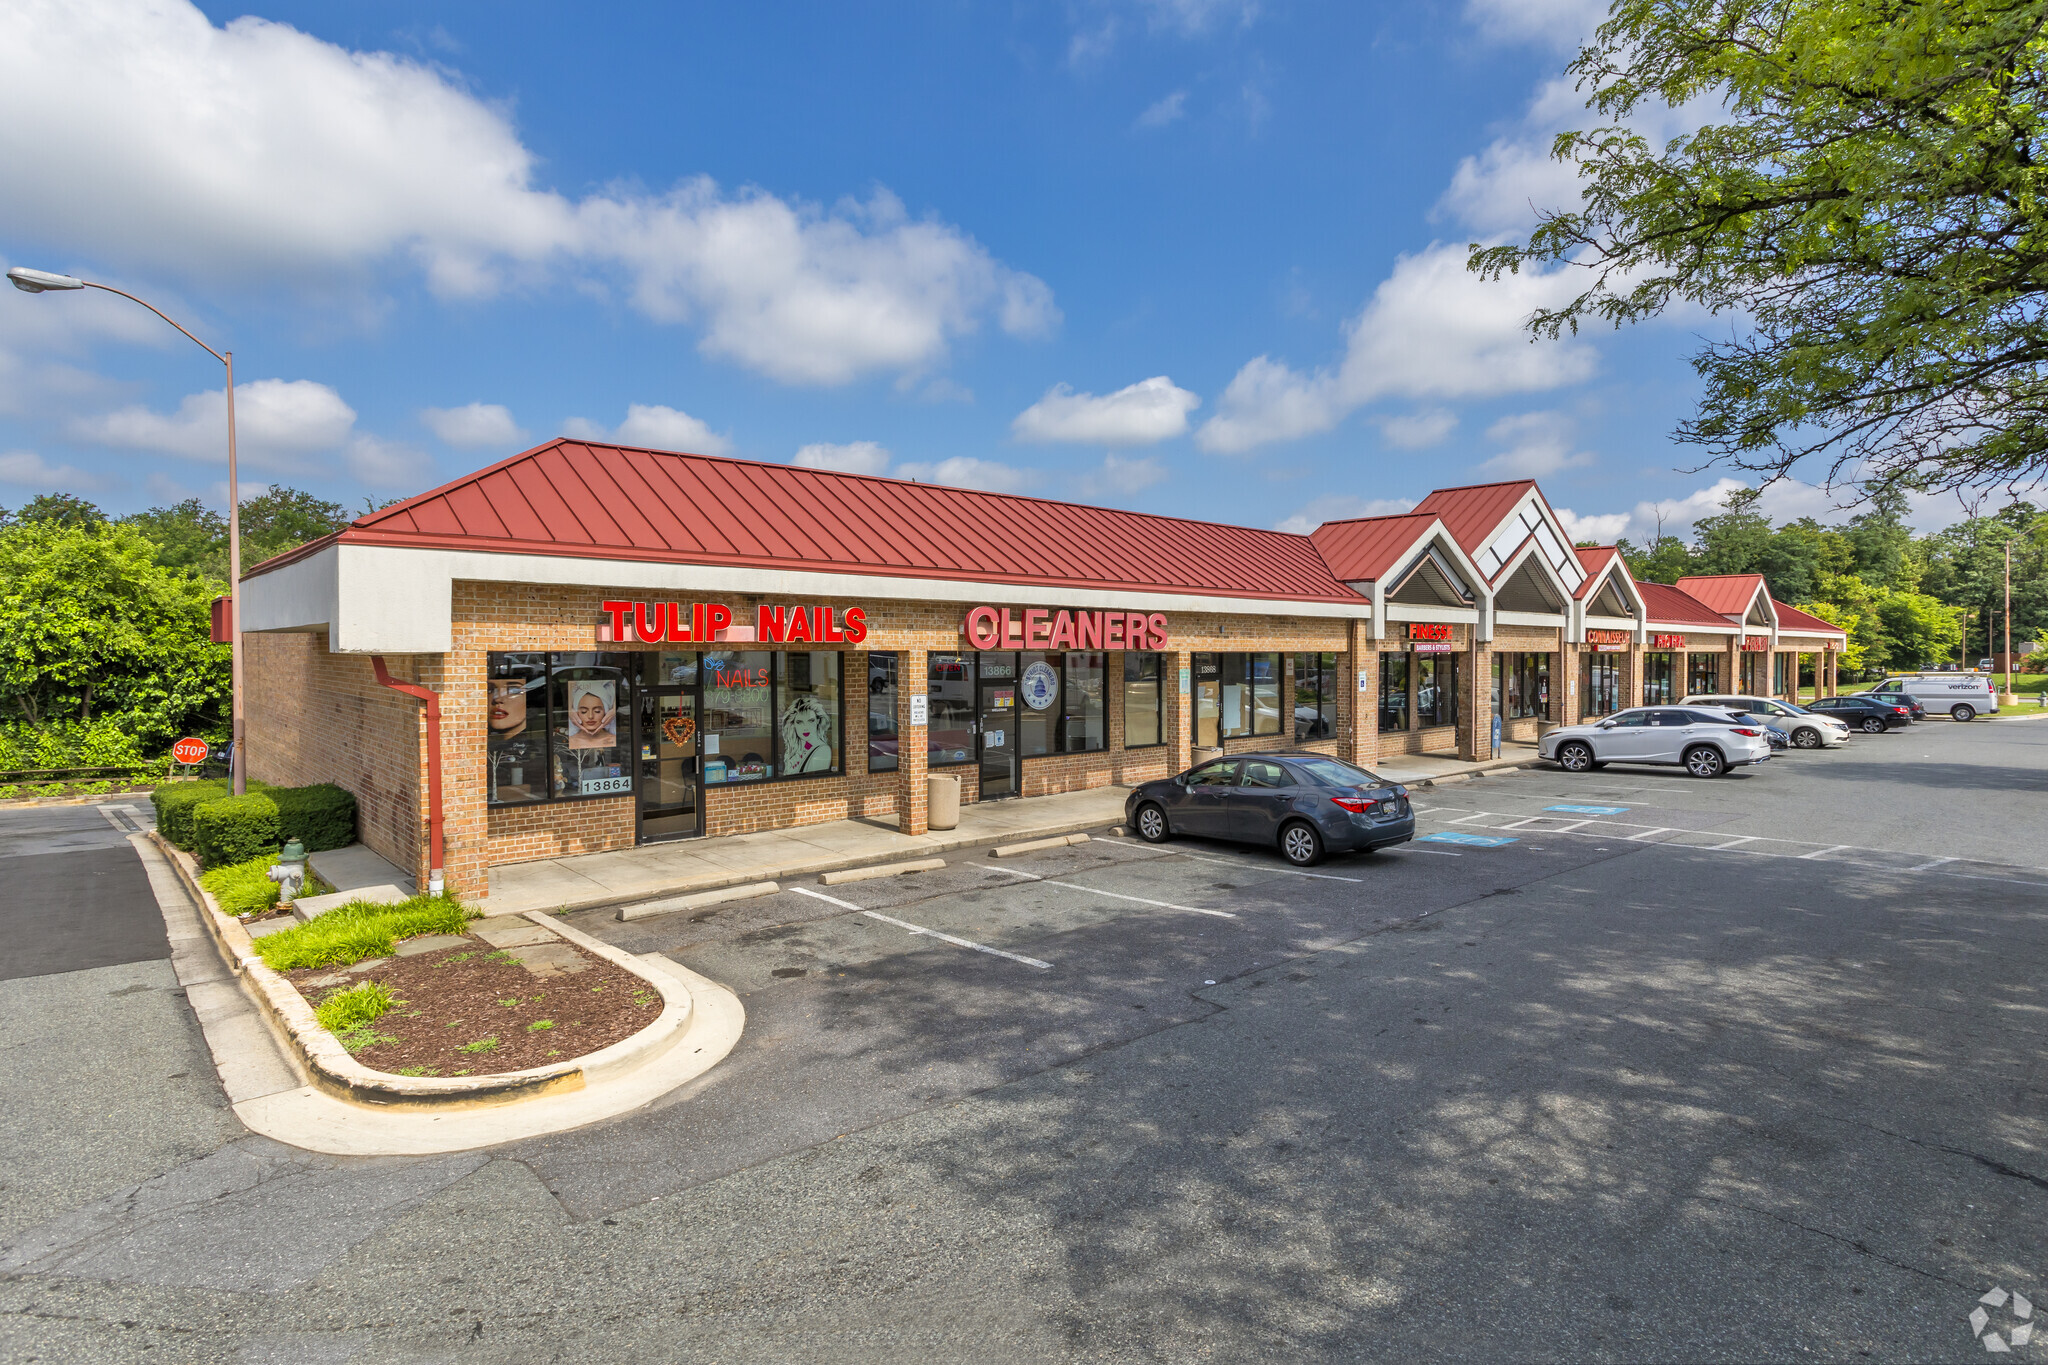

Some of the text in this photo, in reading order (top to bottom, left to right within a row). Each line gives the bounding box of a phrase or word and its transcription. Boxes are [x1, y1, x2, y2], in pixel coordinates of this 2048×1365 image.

[602, 600, 868, 644] TULIP NAILS
[964, 606, 1168, 650] CLEANERS
[1409, 623, 1453, 640] FINESSE
[935, 663, 961, 672] OPEN
[984, 666, 1012, 676] 13866
[1024, 665, 1039, 686] STRICT
[716, 668, 769, 688] NAILS
[175, 744, 206, 757] STOP
[583, 779, 630, 792] 13864
